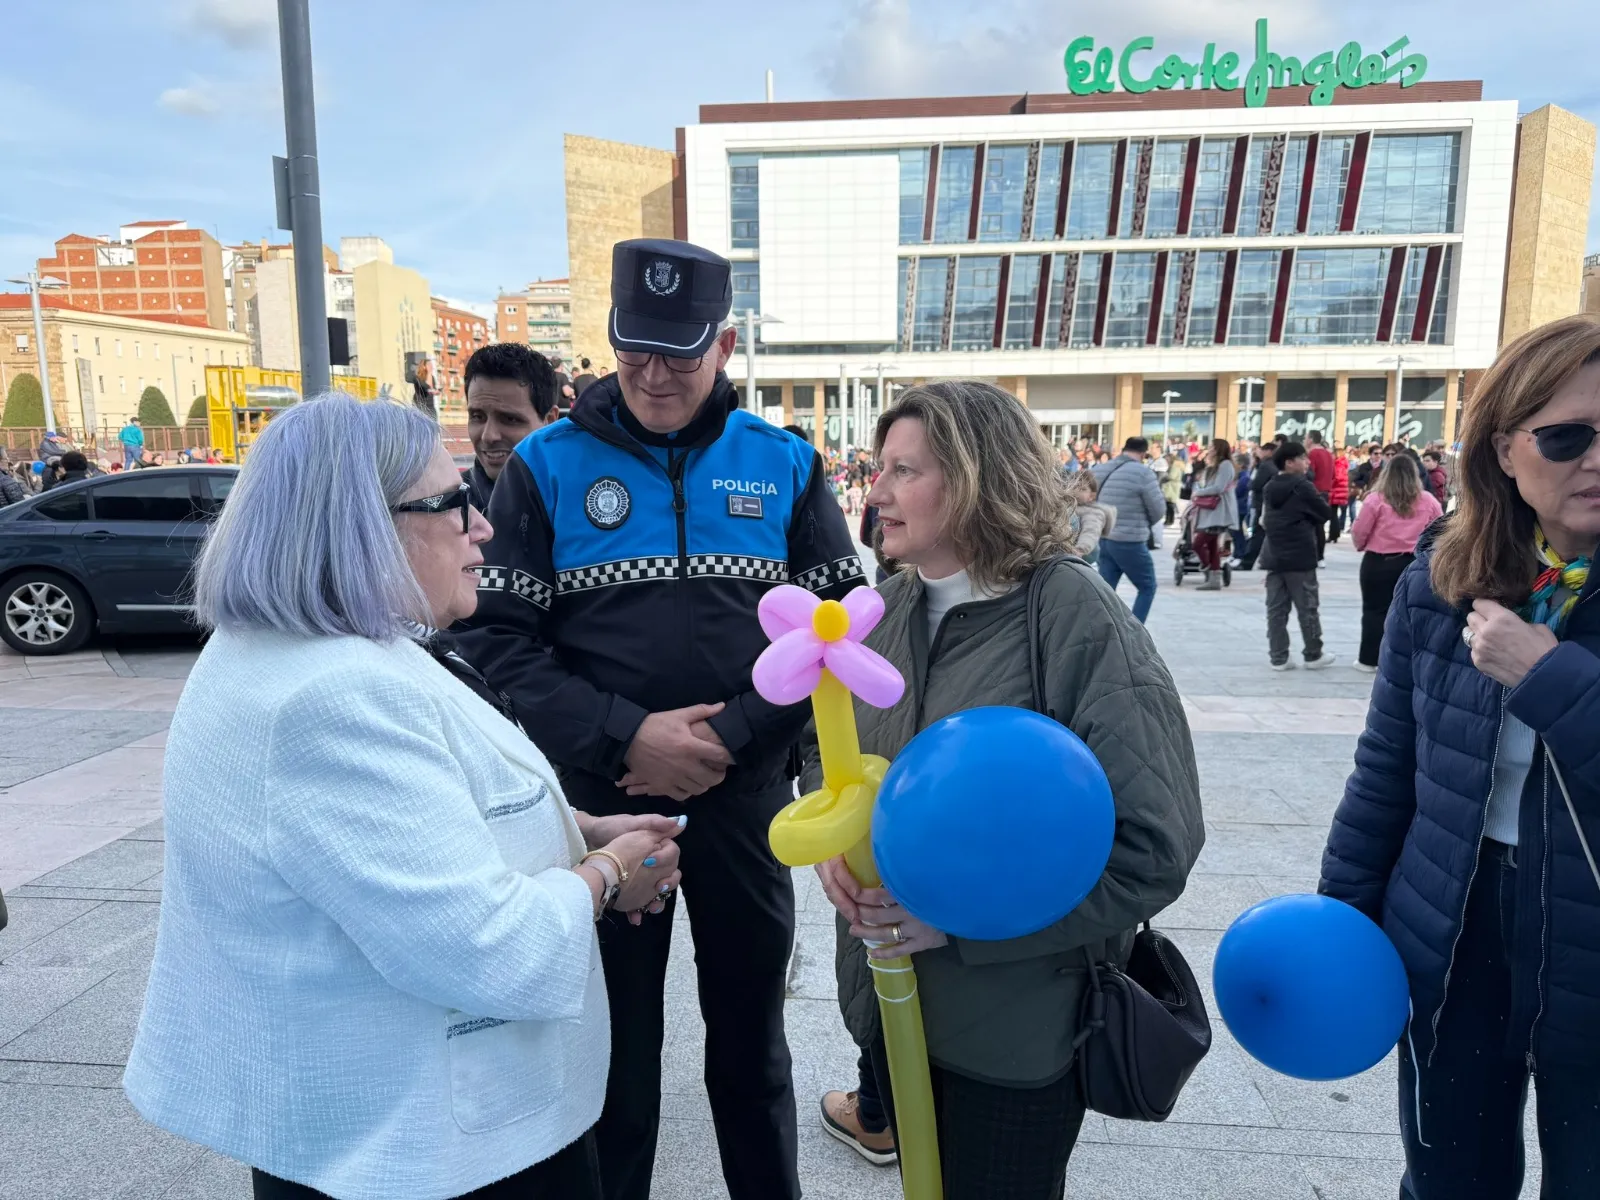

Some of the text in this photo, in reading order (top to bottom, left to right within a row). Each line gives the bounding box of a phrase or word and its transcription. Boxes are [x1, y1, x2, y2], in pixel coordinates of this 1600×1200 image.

[1064, 18, 1428, 108] El Corte Inglés
[1275, 411, 1327, 437] orte
[712, 479, 778, 496] POLICÍA
